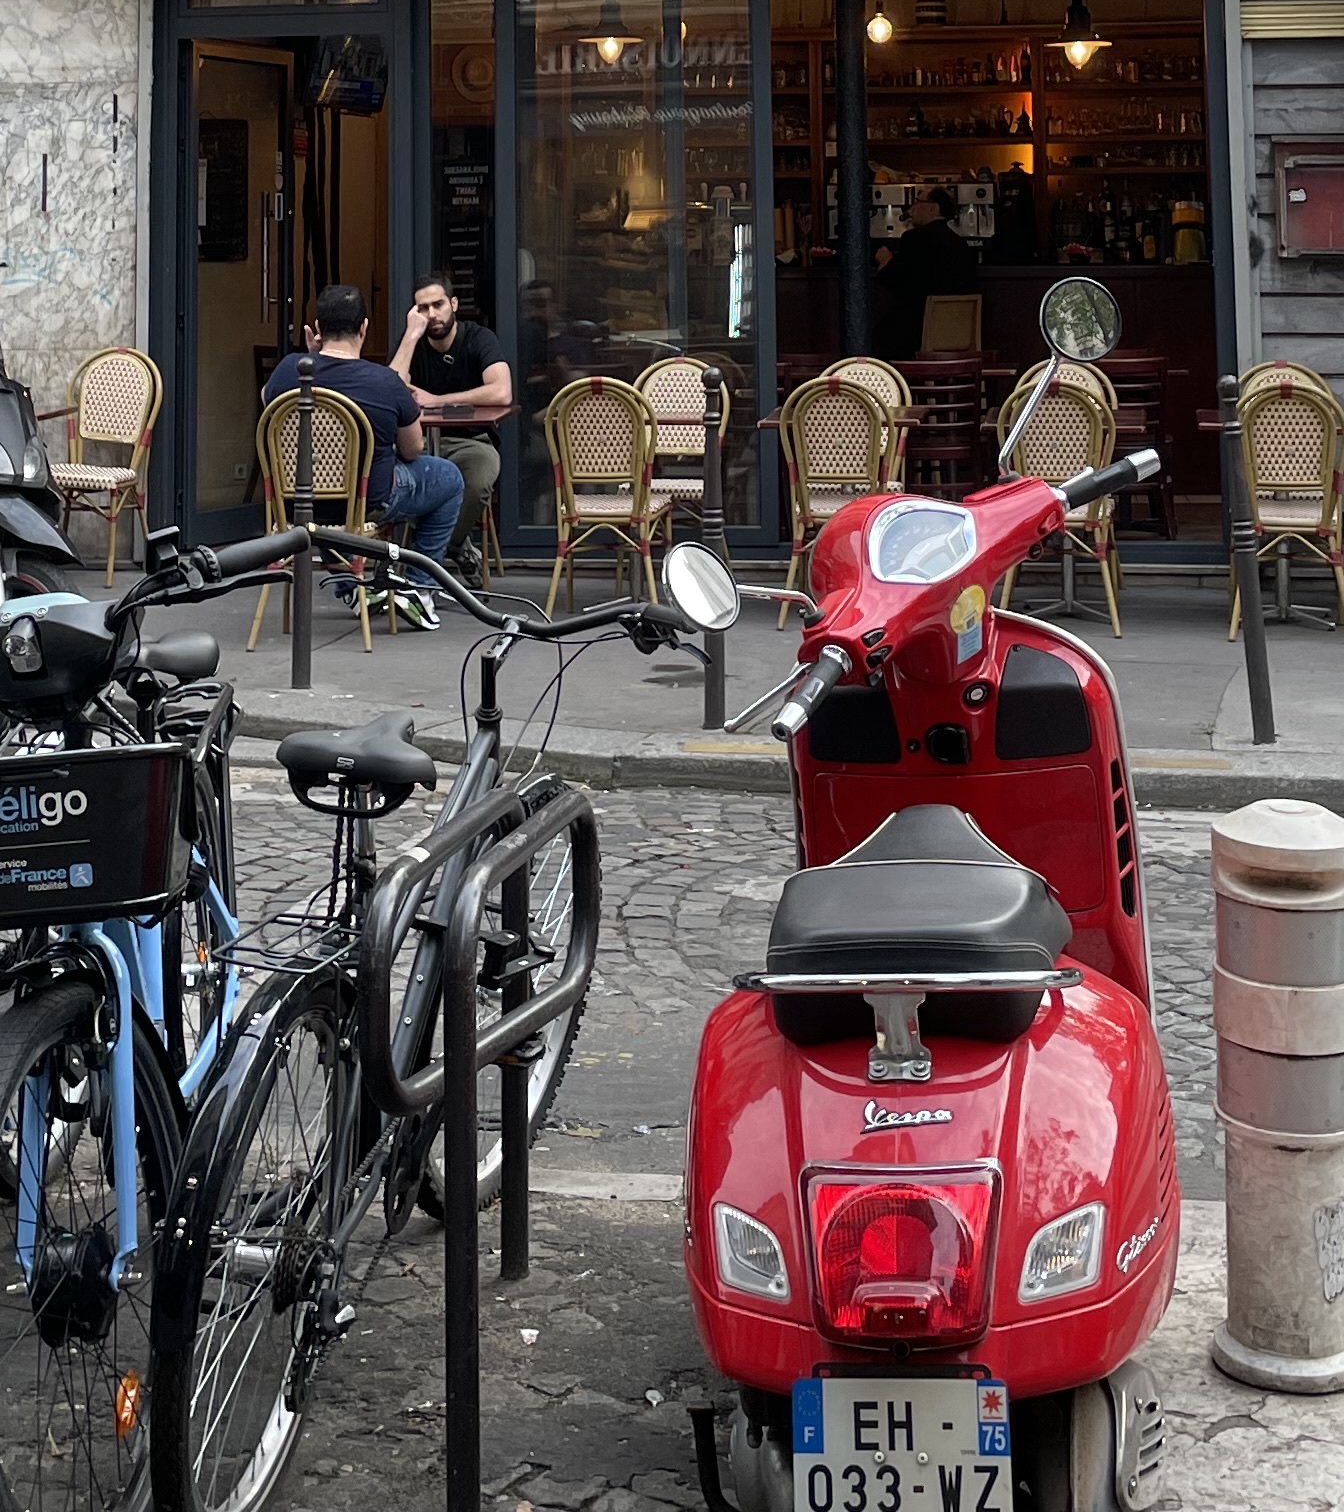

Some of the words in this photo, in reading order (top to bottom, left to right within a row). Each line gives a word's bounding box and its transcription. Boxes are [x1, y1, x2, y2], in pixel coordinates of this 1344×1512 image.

[27, 880, 69, 892] mobilités
[863, 1099, 953, 1131] Vespa
[803, 1426, 816, 1444] F
[981, 1425, 1006, 1451] 75
